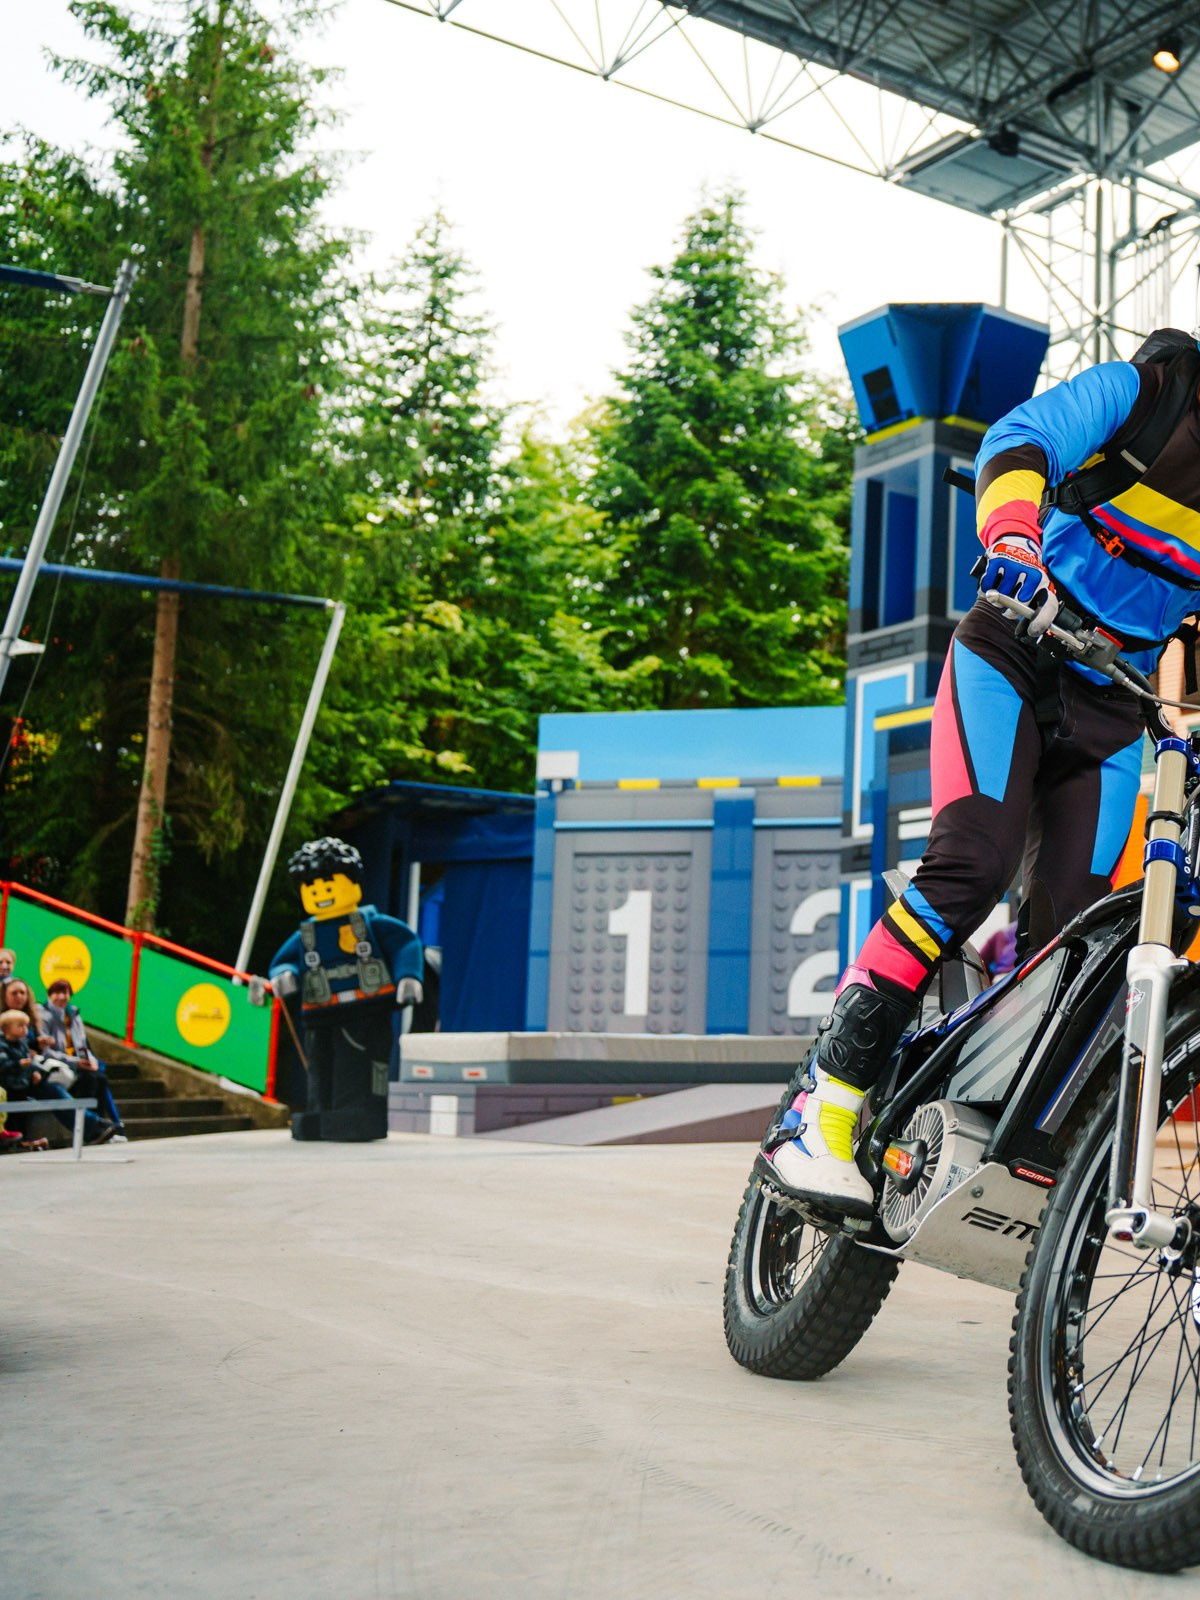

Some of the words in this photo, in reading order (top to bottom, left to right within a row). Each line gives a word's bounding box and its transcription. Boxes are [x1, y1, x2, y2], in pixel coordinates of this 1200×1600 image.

[607, 890, 652, 1016] 1
[787, 888, 840, 1018] 2
[1016, 1166, 1053, 1184] COMP
